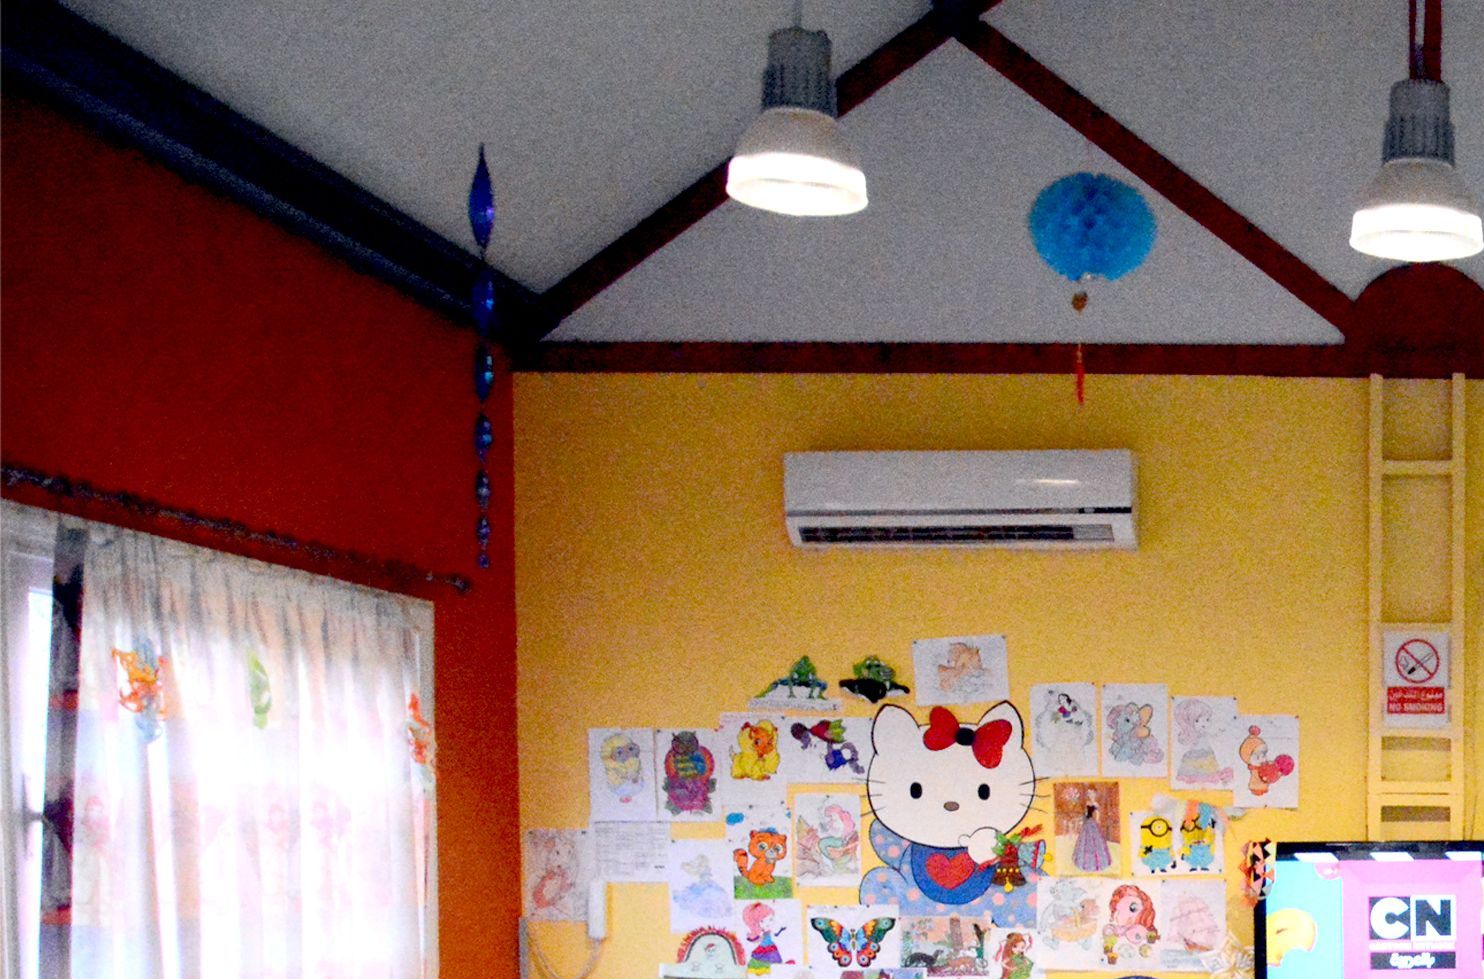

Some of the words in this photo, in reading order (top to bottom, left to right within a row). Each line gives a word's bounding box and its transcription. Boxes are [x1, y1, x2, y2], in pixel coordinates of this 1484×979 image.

[1388, 702, 1402, 712] NO
[1403, 702, 1443, 712] SMOKING
[1369, 896, 1453, 940] CN
